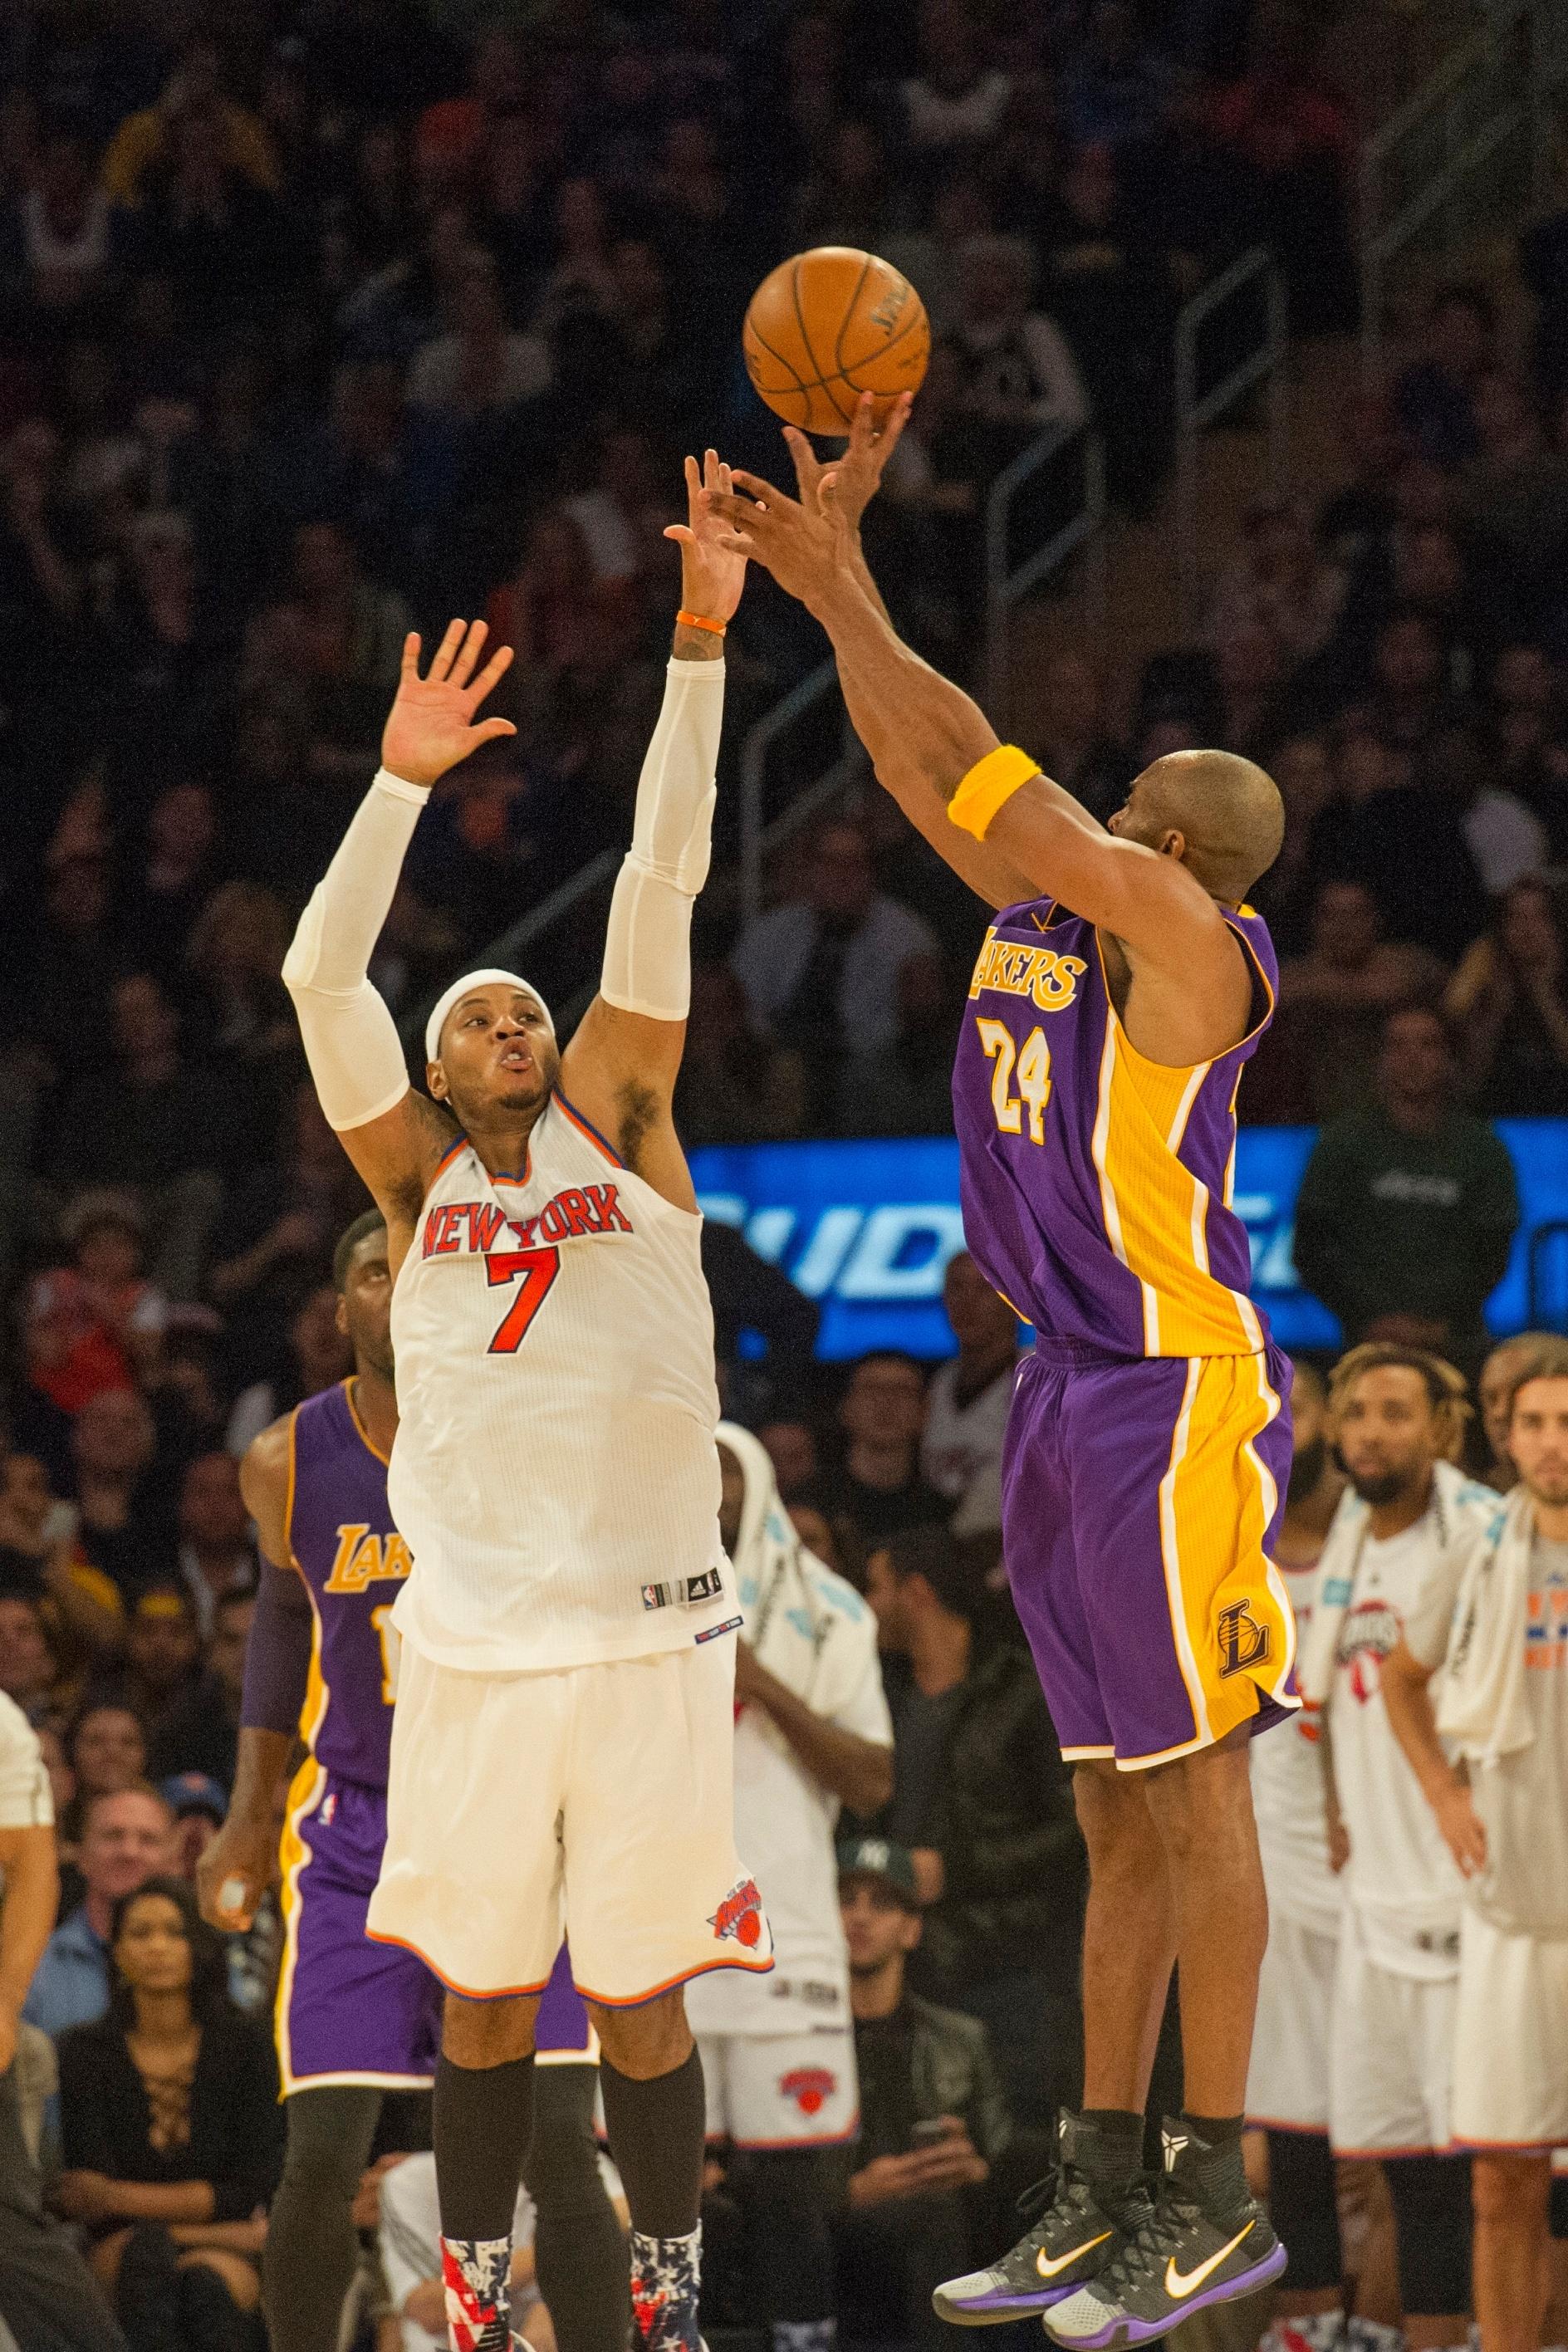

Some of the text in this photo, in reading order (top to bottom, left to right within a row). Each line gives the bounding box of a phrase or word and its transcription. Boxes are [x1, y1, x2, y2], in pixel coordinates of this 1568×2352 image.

[975, 1017, 1051, 1146] 24
[422, 1183, 634, 1260] NEW YORK
[484, 1245, 561, 1354] 7
